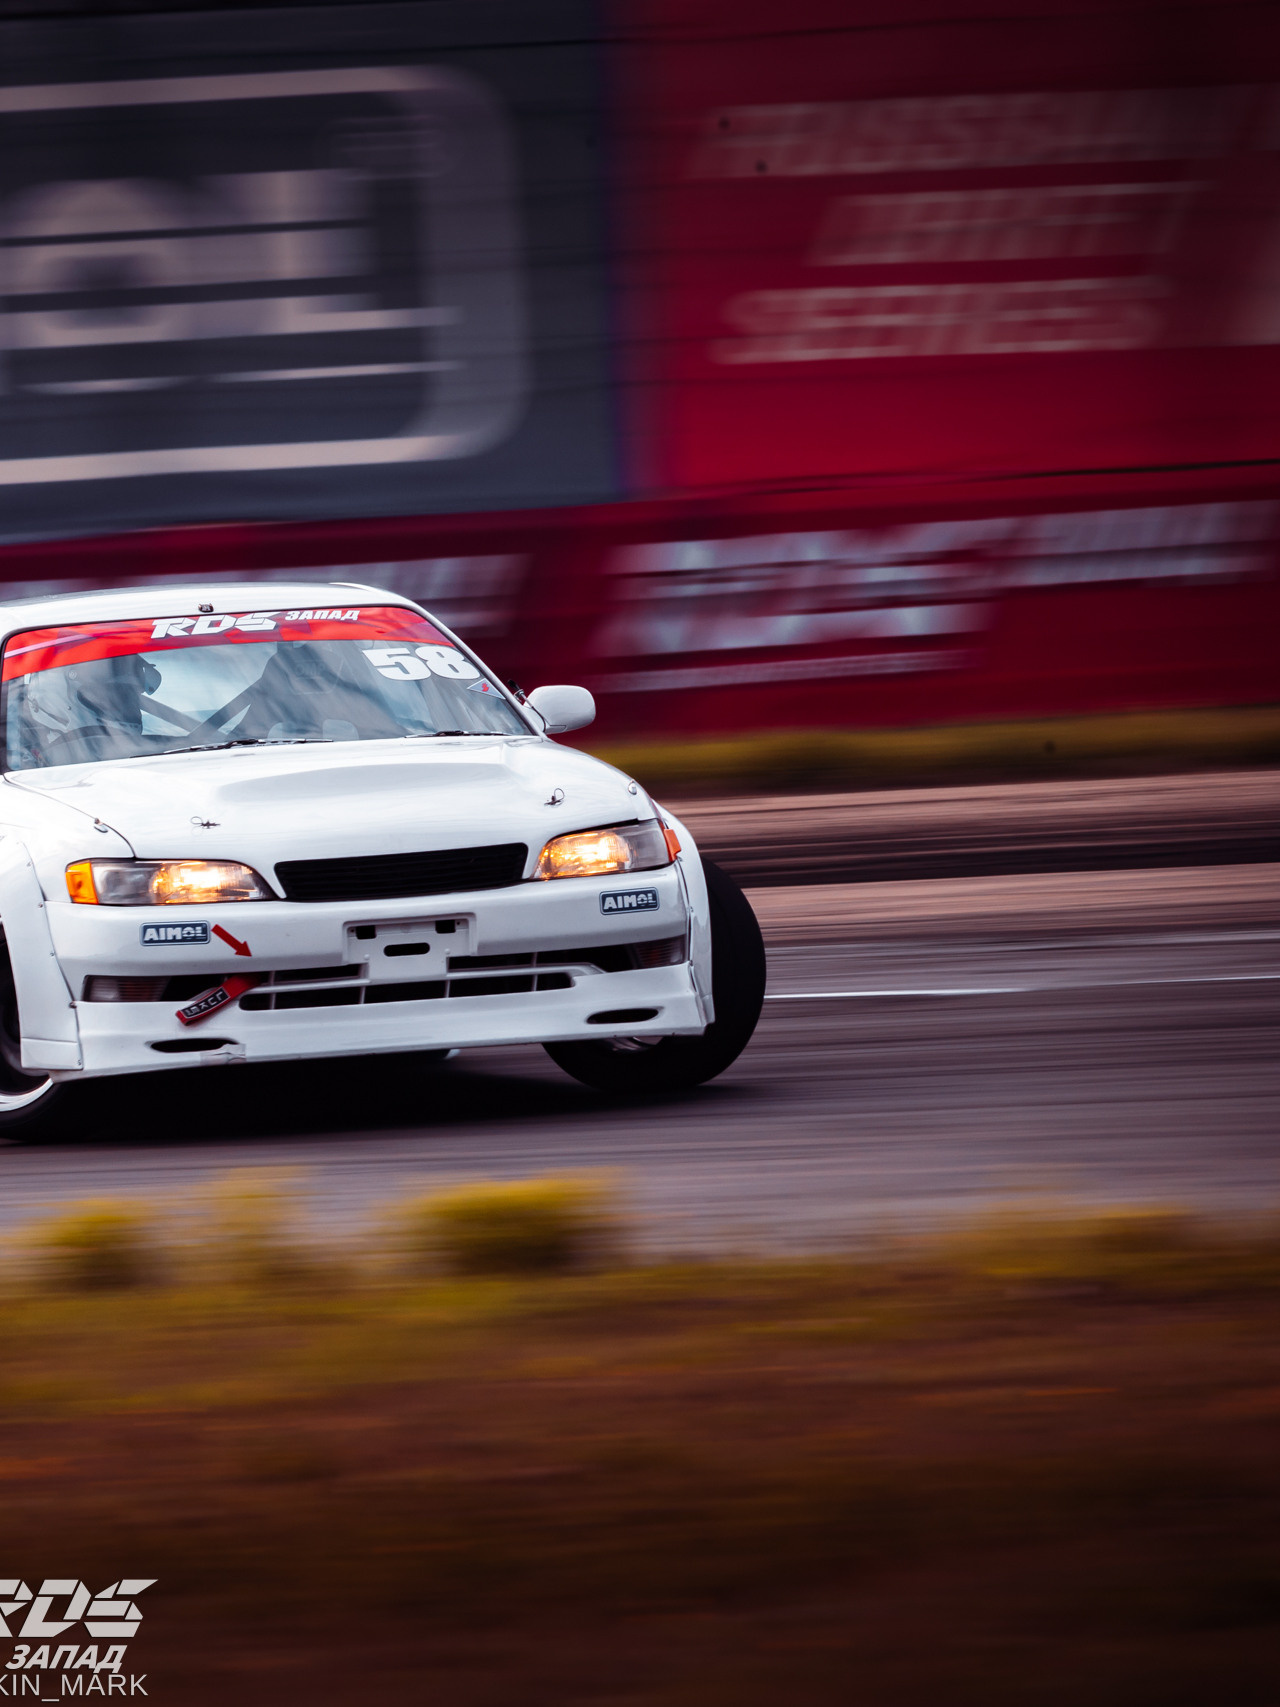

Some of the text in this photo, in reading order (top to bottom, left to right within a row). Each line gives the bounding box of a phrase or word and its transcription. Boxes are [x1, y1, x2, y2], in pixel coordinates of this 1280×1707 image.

[151, 610, 360, 639] RDS ЗАПАД
[362, 645, 480, 681] 58
[603, 893, 656, 910] AIMOL
[143, 926, 207, 942] AIMOL
